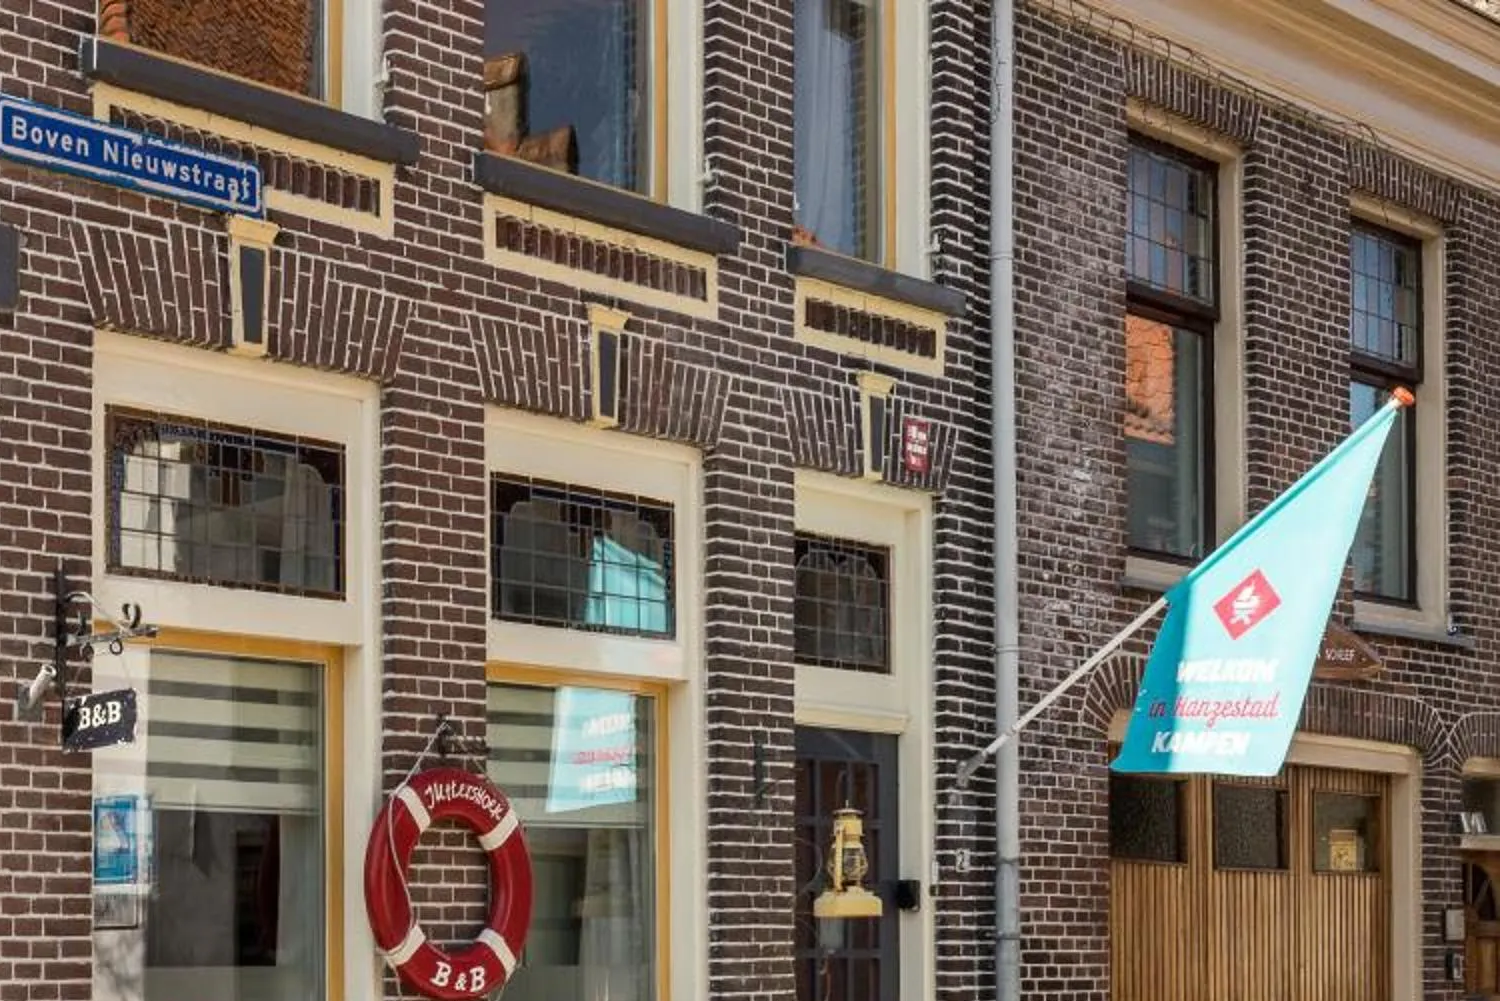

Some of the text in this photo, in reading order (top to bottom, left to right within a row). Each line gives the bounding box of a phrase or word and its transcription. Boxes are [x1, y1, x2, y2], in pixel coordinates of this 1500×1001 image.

[10, 114, 251, 201] Boven Nieuwstraat
[1176, 660, 1280, 682] WELKOM
[77, 701, 123, 731] B&B
[1149, 689, 1280, 729] in Hanzestad
[1151, 731, 1252, 755] KAMPEN
